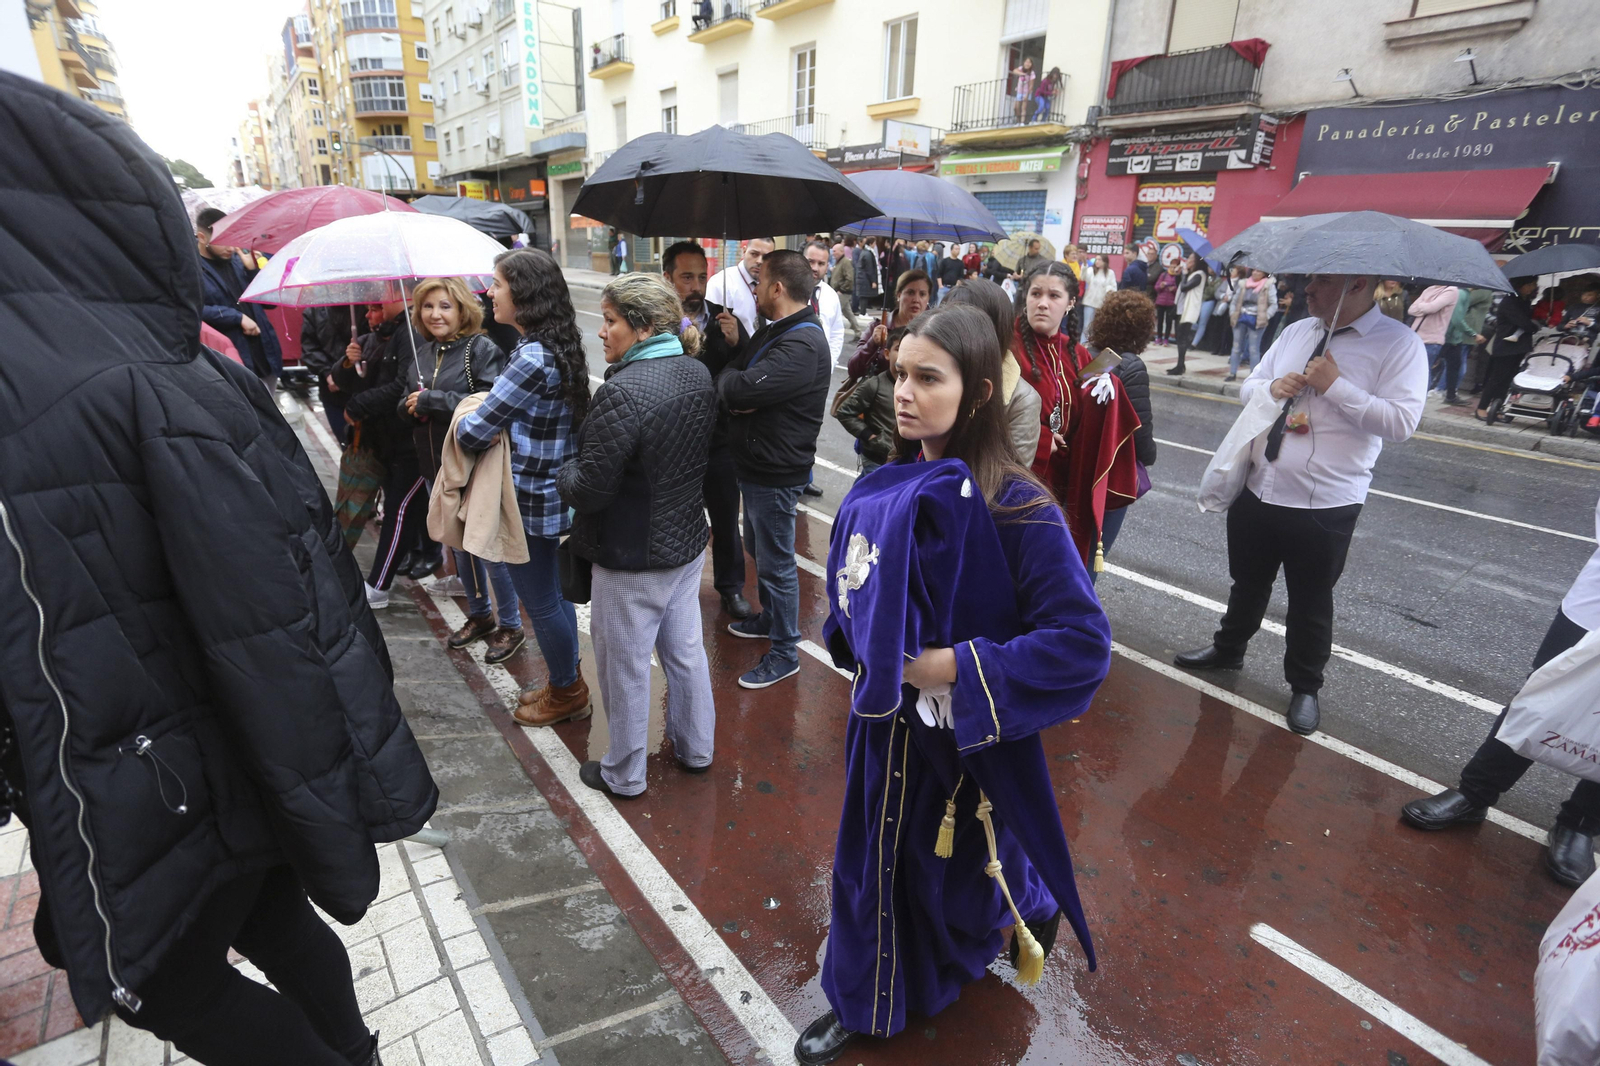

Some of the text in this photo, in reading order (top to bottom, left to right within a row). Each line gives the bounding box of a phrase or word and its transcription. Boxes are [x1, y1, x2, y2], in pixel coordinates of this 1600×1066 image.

[1317, 103, 1600, 142] Panadería & Pasteler
[1407, 143, 1494, 161] desde 1989
[955, 164, 978, 174] FRUTAS
[1138, 186, 1216, 202] CERRAJERO
[1539, 730, 1600, 766] ZAMA
